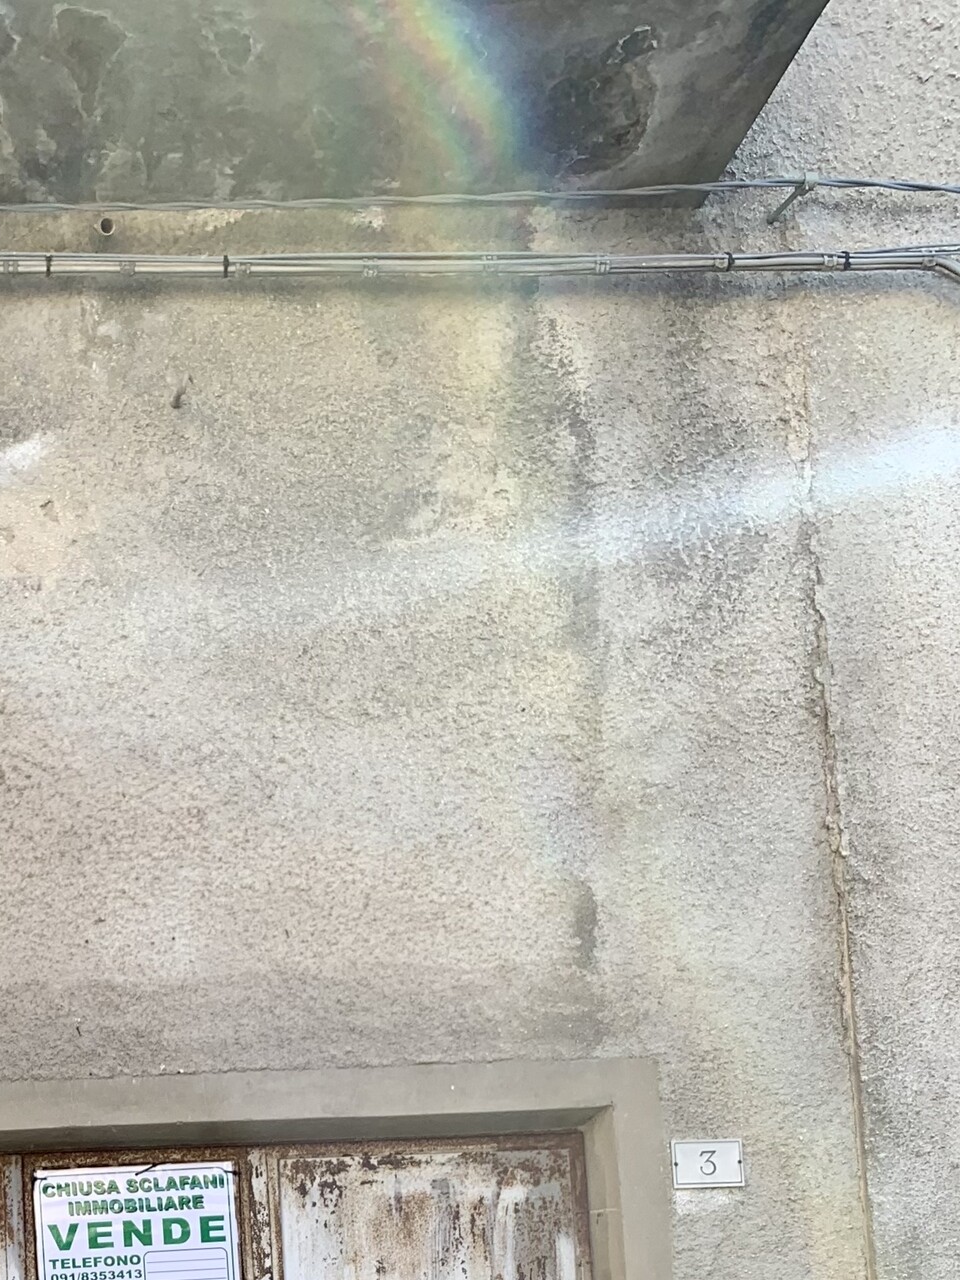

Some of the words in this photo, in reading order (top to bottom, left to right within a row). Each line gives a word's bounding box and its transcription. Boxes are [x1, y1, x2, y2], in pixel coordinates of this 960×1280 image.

[699, 1150, 717, 1176] 3
[42, 1179, 121, 1198] CHIUSA
[126, 1174, 225, 1194] SCLAFANI
[68, 1194, 205, 1217] IMMOBILIARE
[47, 1215, 227, 1251] VENDE
[49, 1254, 141, 1270] TELEFONO
